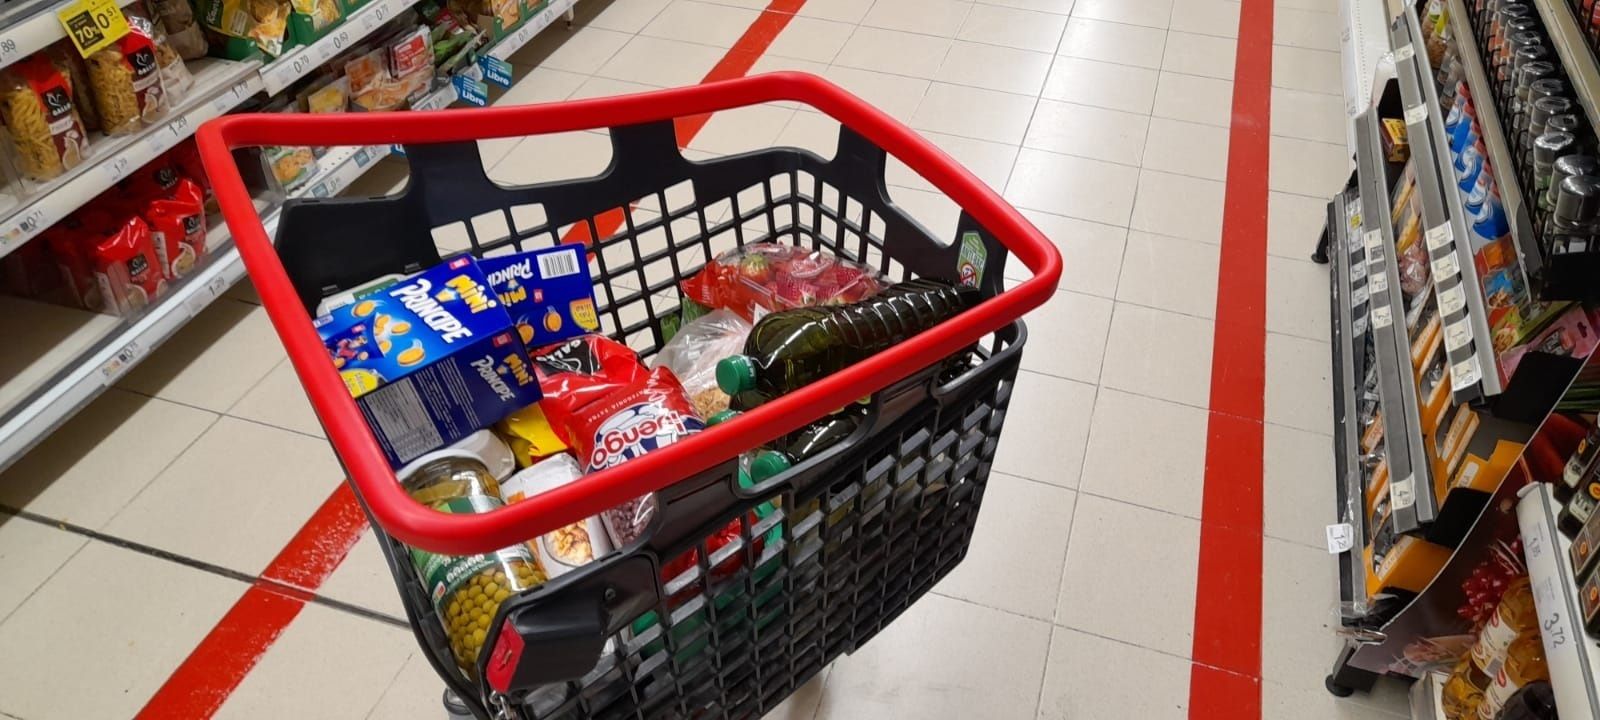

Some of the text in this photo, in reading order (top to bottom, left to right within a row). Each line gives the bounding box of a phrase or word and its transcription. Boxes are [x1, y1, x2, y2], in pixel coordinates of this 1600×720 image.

[487, 69, 509, 86] Libre
[462, 90, 485, 106] Libre
[487, 258, 534, 288] PRINCI
